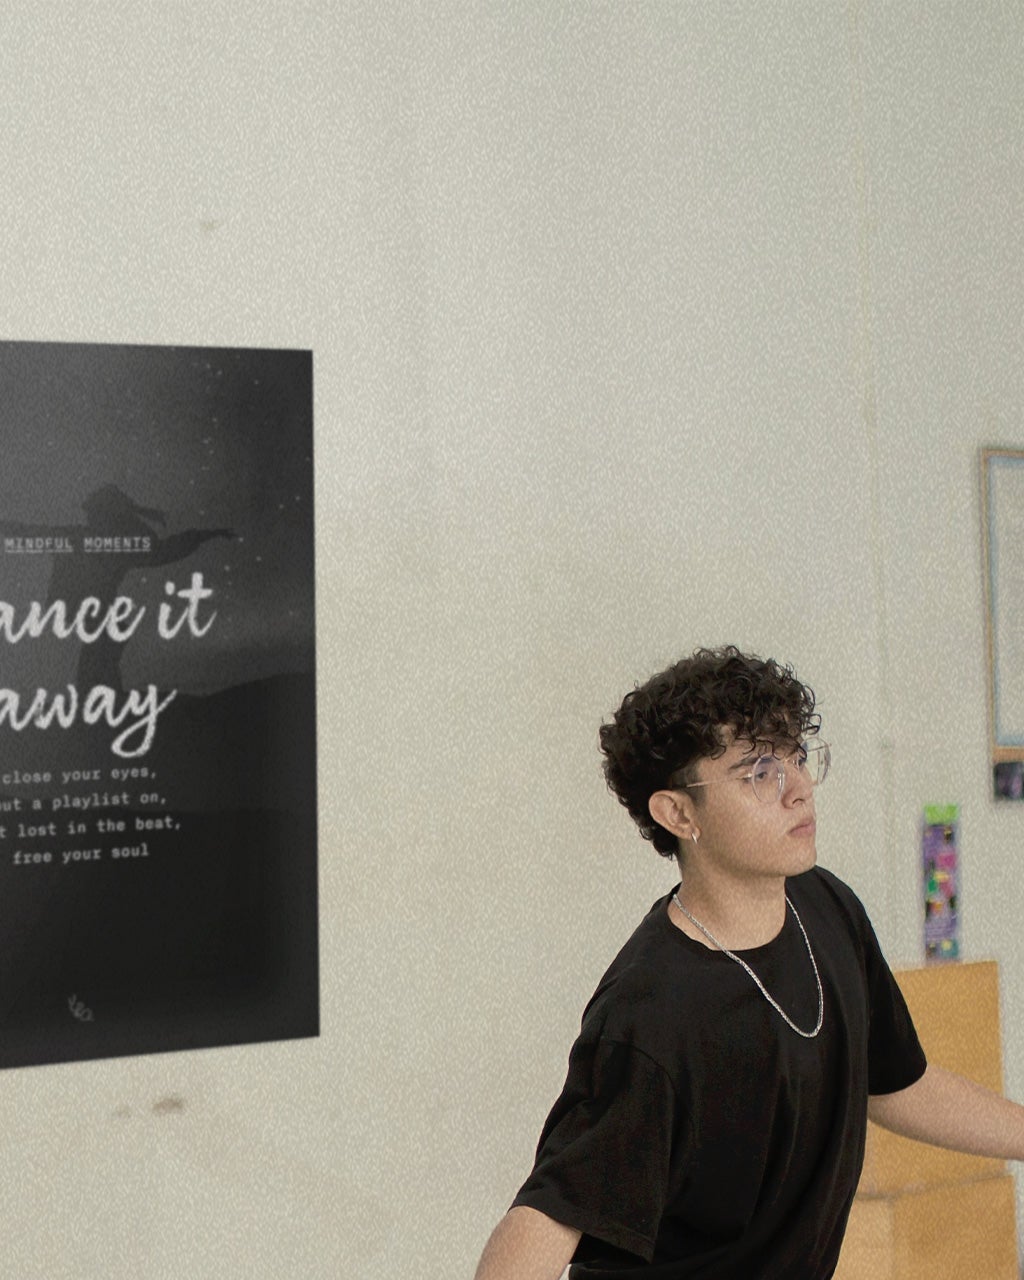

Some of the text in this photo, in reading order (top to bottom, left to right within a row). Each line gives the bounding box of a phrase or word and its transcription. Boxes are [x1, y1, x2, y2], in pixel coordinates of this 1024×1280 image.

[4, 536, 151, 550] MINDFUL MOMENTS
[158, 571, 217, 641] it
[2, 767, 156, 784] close your eyes,
[32, 799, 42, 810] a
[52, 792, 129, 811] playlist
[140, 792, 166, 805] on,
[18, 822, 56, 838] lost
[68, 820, 86, 835] in
[96, 819, 125, 832] the
[135, 815, 181, 831] beat,
[13, 842, 149, 865] free your soul
